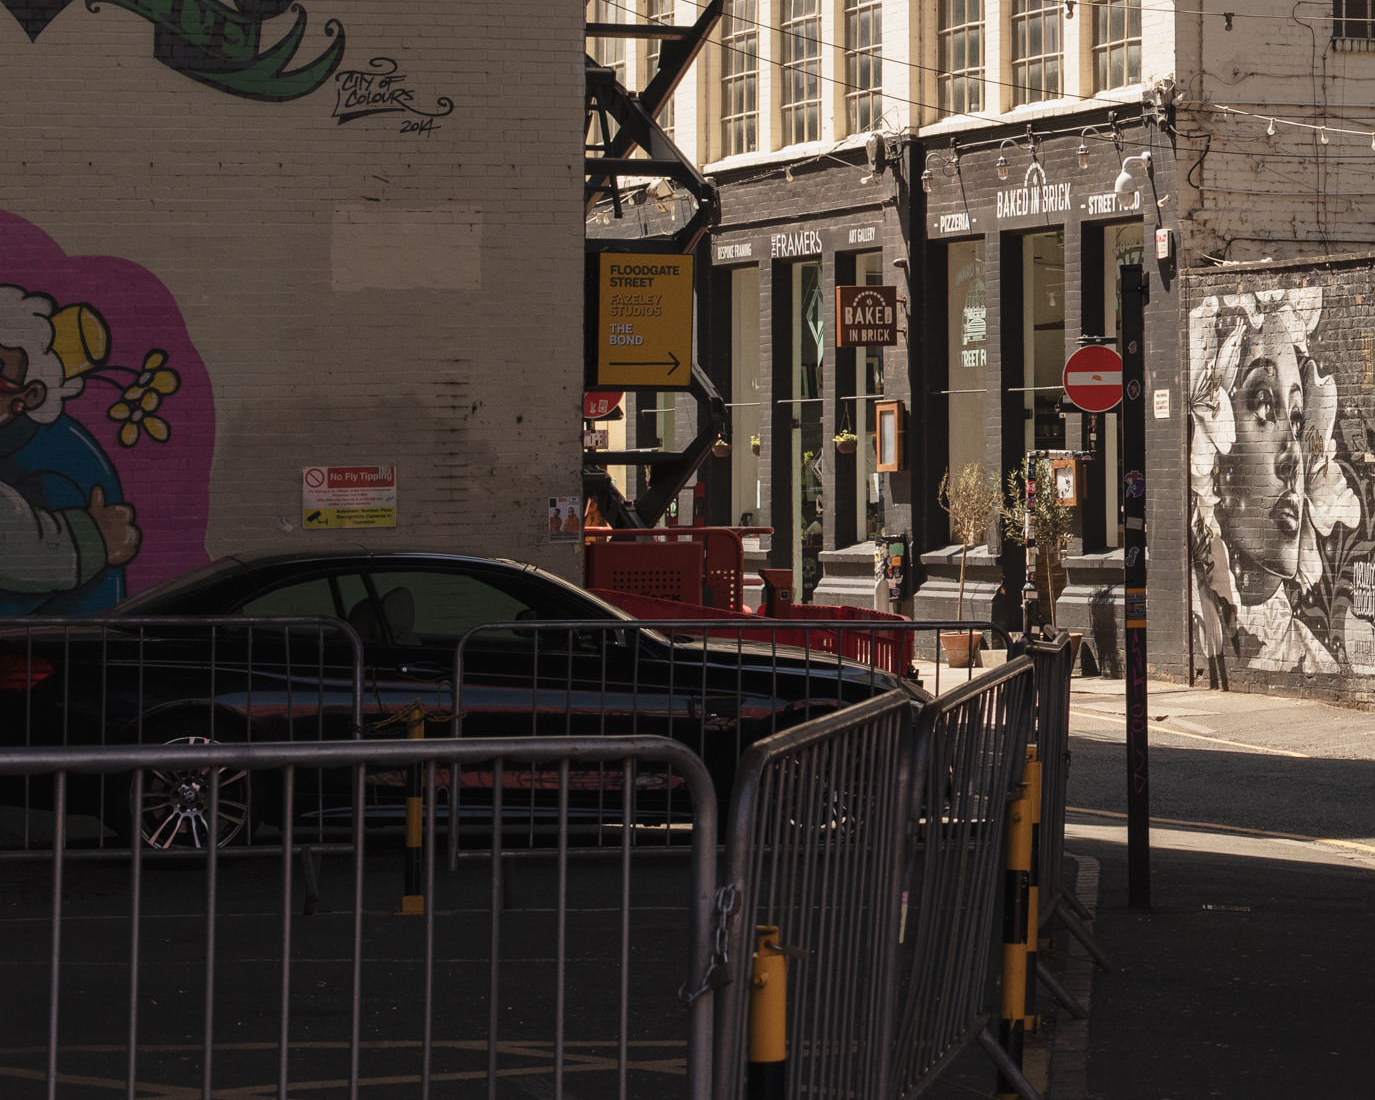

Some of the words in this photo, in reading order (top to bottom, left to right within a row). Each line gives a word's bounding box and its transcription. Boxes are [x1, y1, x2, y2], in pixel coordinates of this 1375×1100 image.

[337, 70, 374, 91] CITY
[379, 75, 407, 91] OF
[345, 89, 415, 107] COLOURS
[400, 118, 441, 138] 2014
[997, 188, 1029, 219] BAKED
[1031, 187, 1041, 214] IN
[1042, 183, 1071, 213] BRICK
[1088, 194, 1117, 215] STREET
[940, 213, 970, 233] PIZZERIA
[776, 231, 822, 257] FRAMERS
[848, 229, 857, 244] ART
[610, 265, 680, 276] FLOODGATE
[610, 277, 654, 287] STREET
[611, 295, 662, 305] FAZELEY
[610, 306, 662, 316] STUDIOS
[845, 306, 892, 325] BAKED
[610, 324, 633, 334] THE
[849, 329, 858, 341] IN
[862, 329, 890, 341] BRICK
[610, 335, 644, 346] BOND
[345, 473, 358, 482] Fly
[360, 472, 392, 481] Tipping
